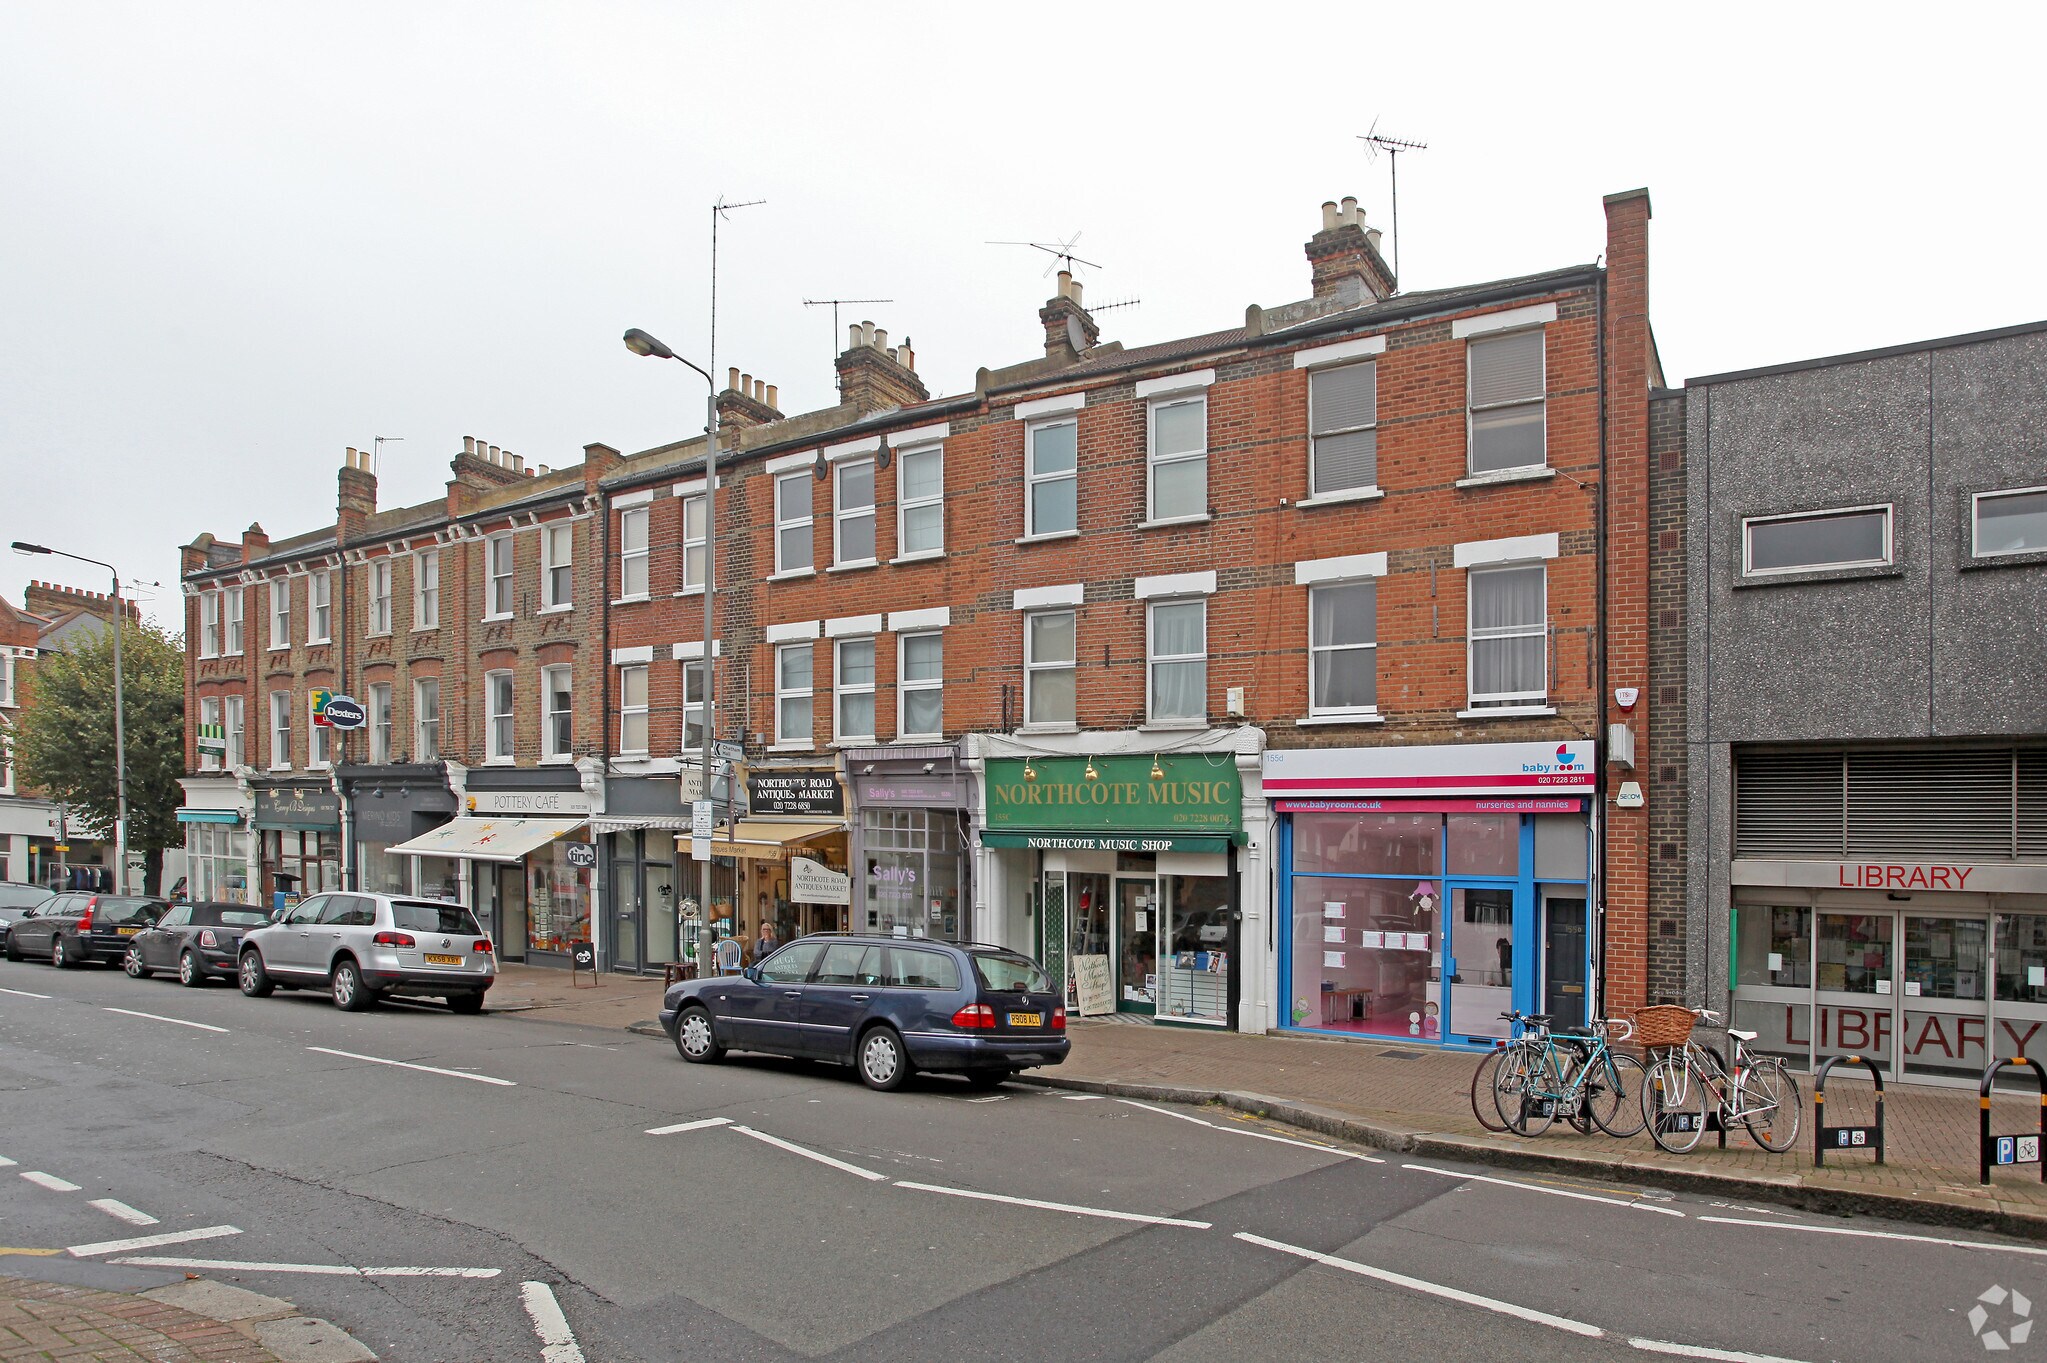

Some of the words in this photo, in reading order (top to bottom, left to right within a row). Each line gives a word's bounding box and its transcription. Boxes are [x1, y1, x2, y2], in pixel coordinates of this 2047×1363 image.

[327, 706, 362, 720] Dexters
[1266, 754, 1284, 762] 155d
[1522, 763, 1550, 773] baby
[1554, 763, 1584, 771] room
[810, 779, 832, 788] ROAD
[757, 790, 795, 800] ANTIQUES
[799, 790, 834, 799] MARKET
[869, 788, 895, 799] Sally's
[995, 782, 1140, 805] NORTHCOTE
[1147, 781, 1231, 805] MUSIC
[494, 795, 532, 809] POTTERY
[535, 793, 559, 809] CAFÉ
[773, 802, 783, 810] 020
[784, 802, 797, 810] 7228
[798, 802, 811, 810] 6850
[1285, 801, 1382, 810] www.babyroom.co.uk
[1476, 801, 1515, 809] nurseries
[1518, 800, 1533, 808] and
[1536, 800, 1568, 809] nannies
[362, 810, 385, 820] MERINO
[386, 810, 401, 821] KIDS
[1173, 813, 1187, 823] 020
[1189, 814, 1208, 823] 7228
[1210, 814, 1229, 823] 0074
[1027, 838, 1095, 849] NORTHCOTE
[1099, 839, 1138, 850] MUSIC
[1141, 840, 1173, 851] SHOP
[729, 846, 747, 854] Market
[796, 874, 830, 883] NORTHCOTE
[873, 865, 916, 885] Sally's
[1840, 865, 1973, 889] LIBRARY
[795, 883, 822, 891] ANTIQUES
[428, 955, 446, 963] KX58
[773, 956, 795, 964] HUGE
[1010, 1014, 1027, 1024] R908
[1786, 1005, 2043, 1059] LIBRARY
[2001, 1139, 2011, 1161] P
